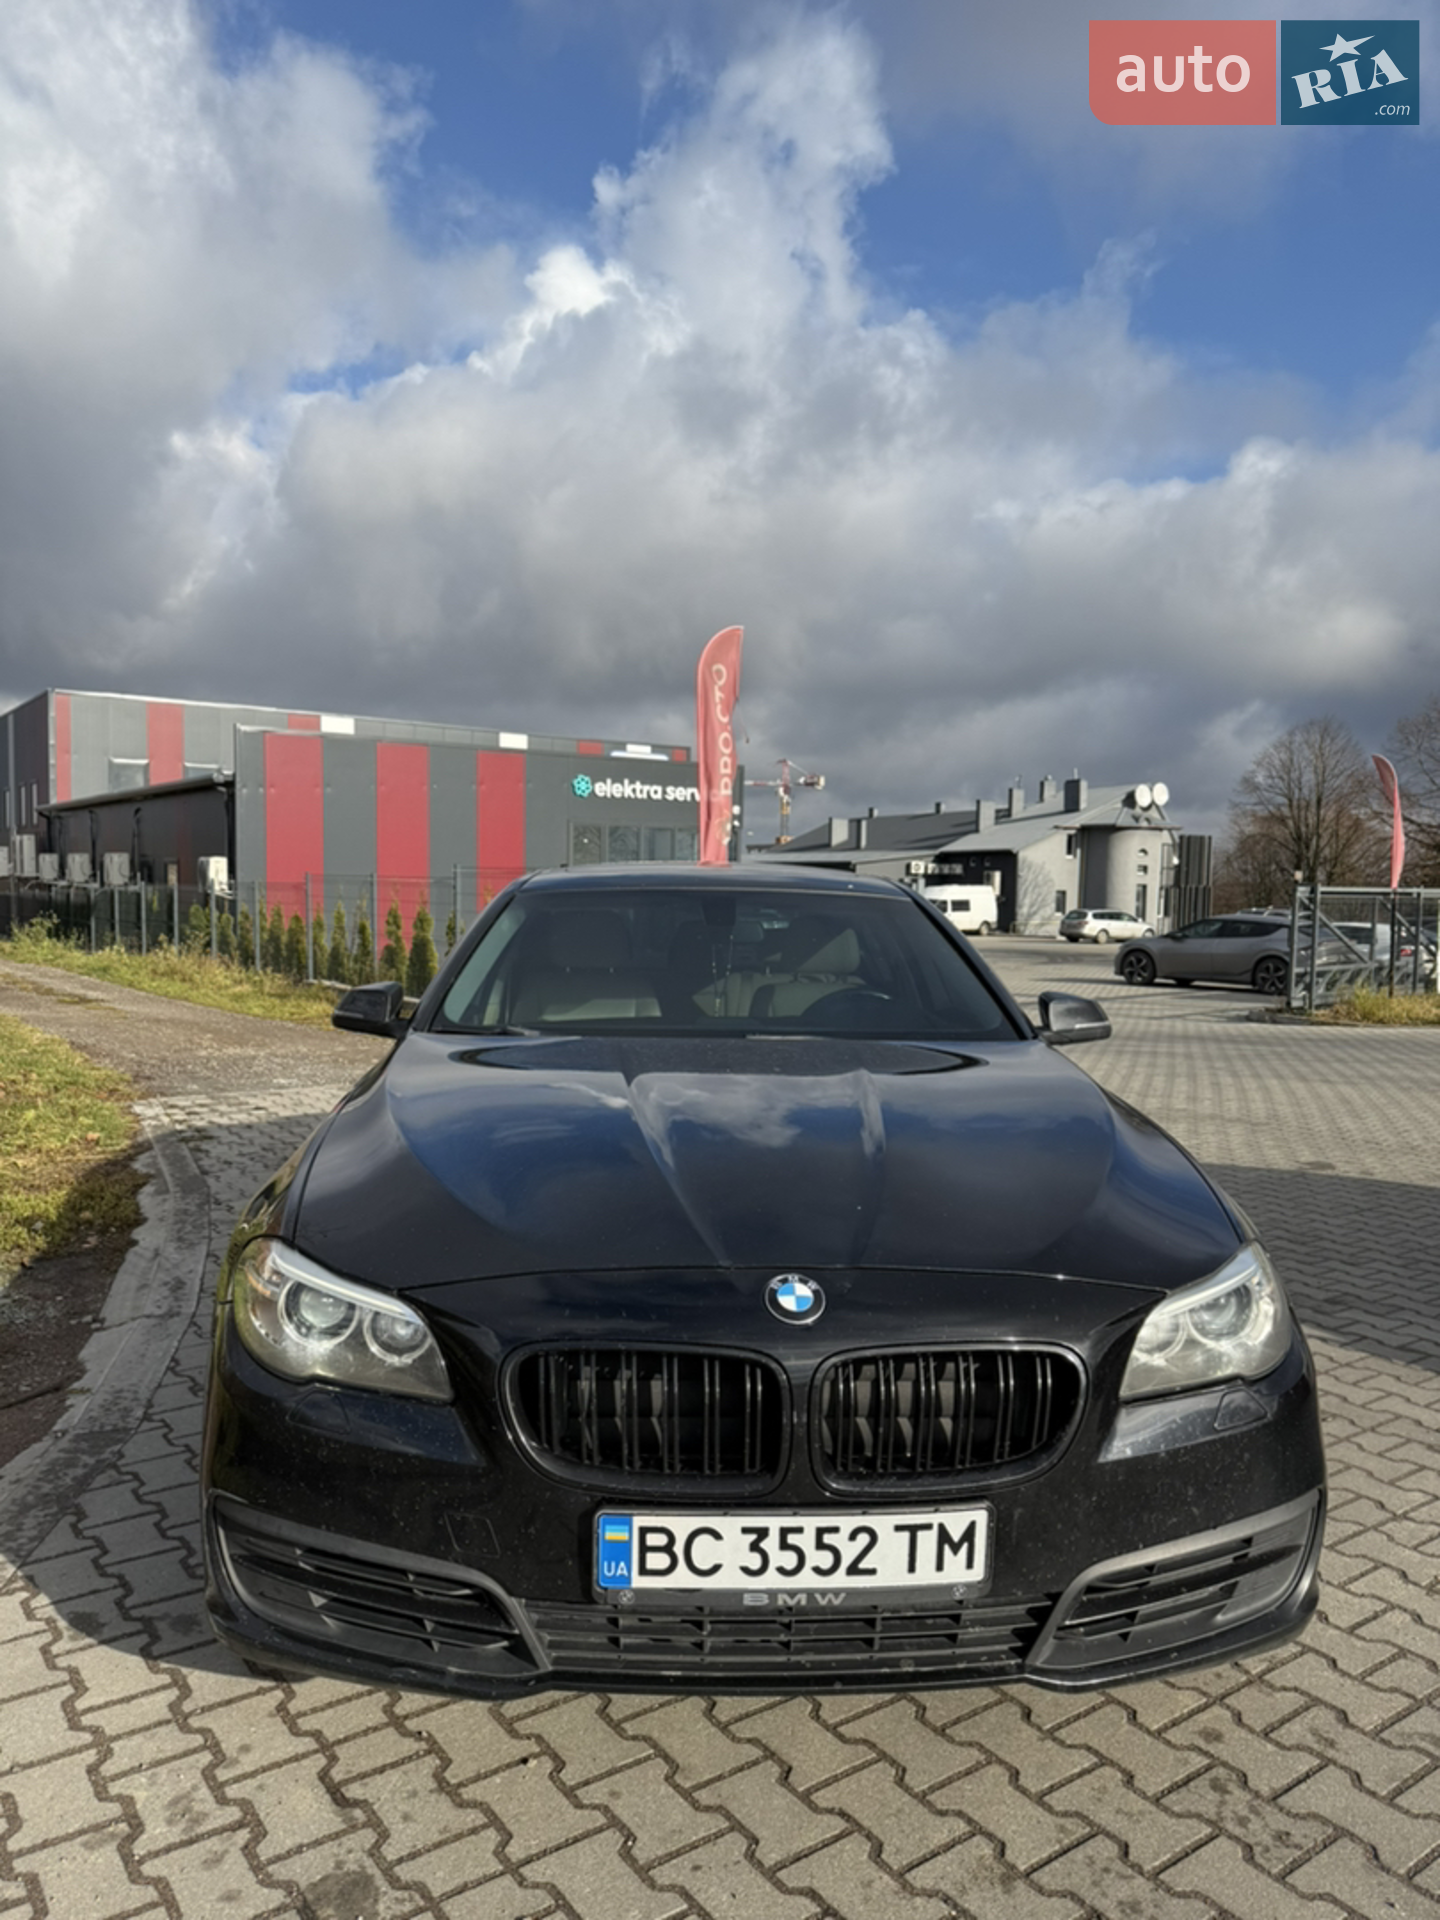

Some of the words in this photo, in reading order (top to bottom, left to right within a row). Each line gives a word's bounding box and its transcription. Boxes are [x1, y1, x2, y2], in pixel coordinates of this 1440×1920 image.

[594, 778, 662, 800] elektra
[638, 1525, 724, 1578] BC
[739, 1525, 879, 1578] 3552
[893, 1519, 977, 1574] TM
[603, 1560, 629, 1577] UA
[742, 1592, 847, 1606] BMW
